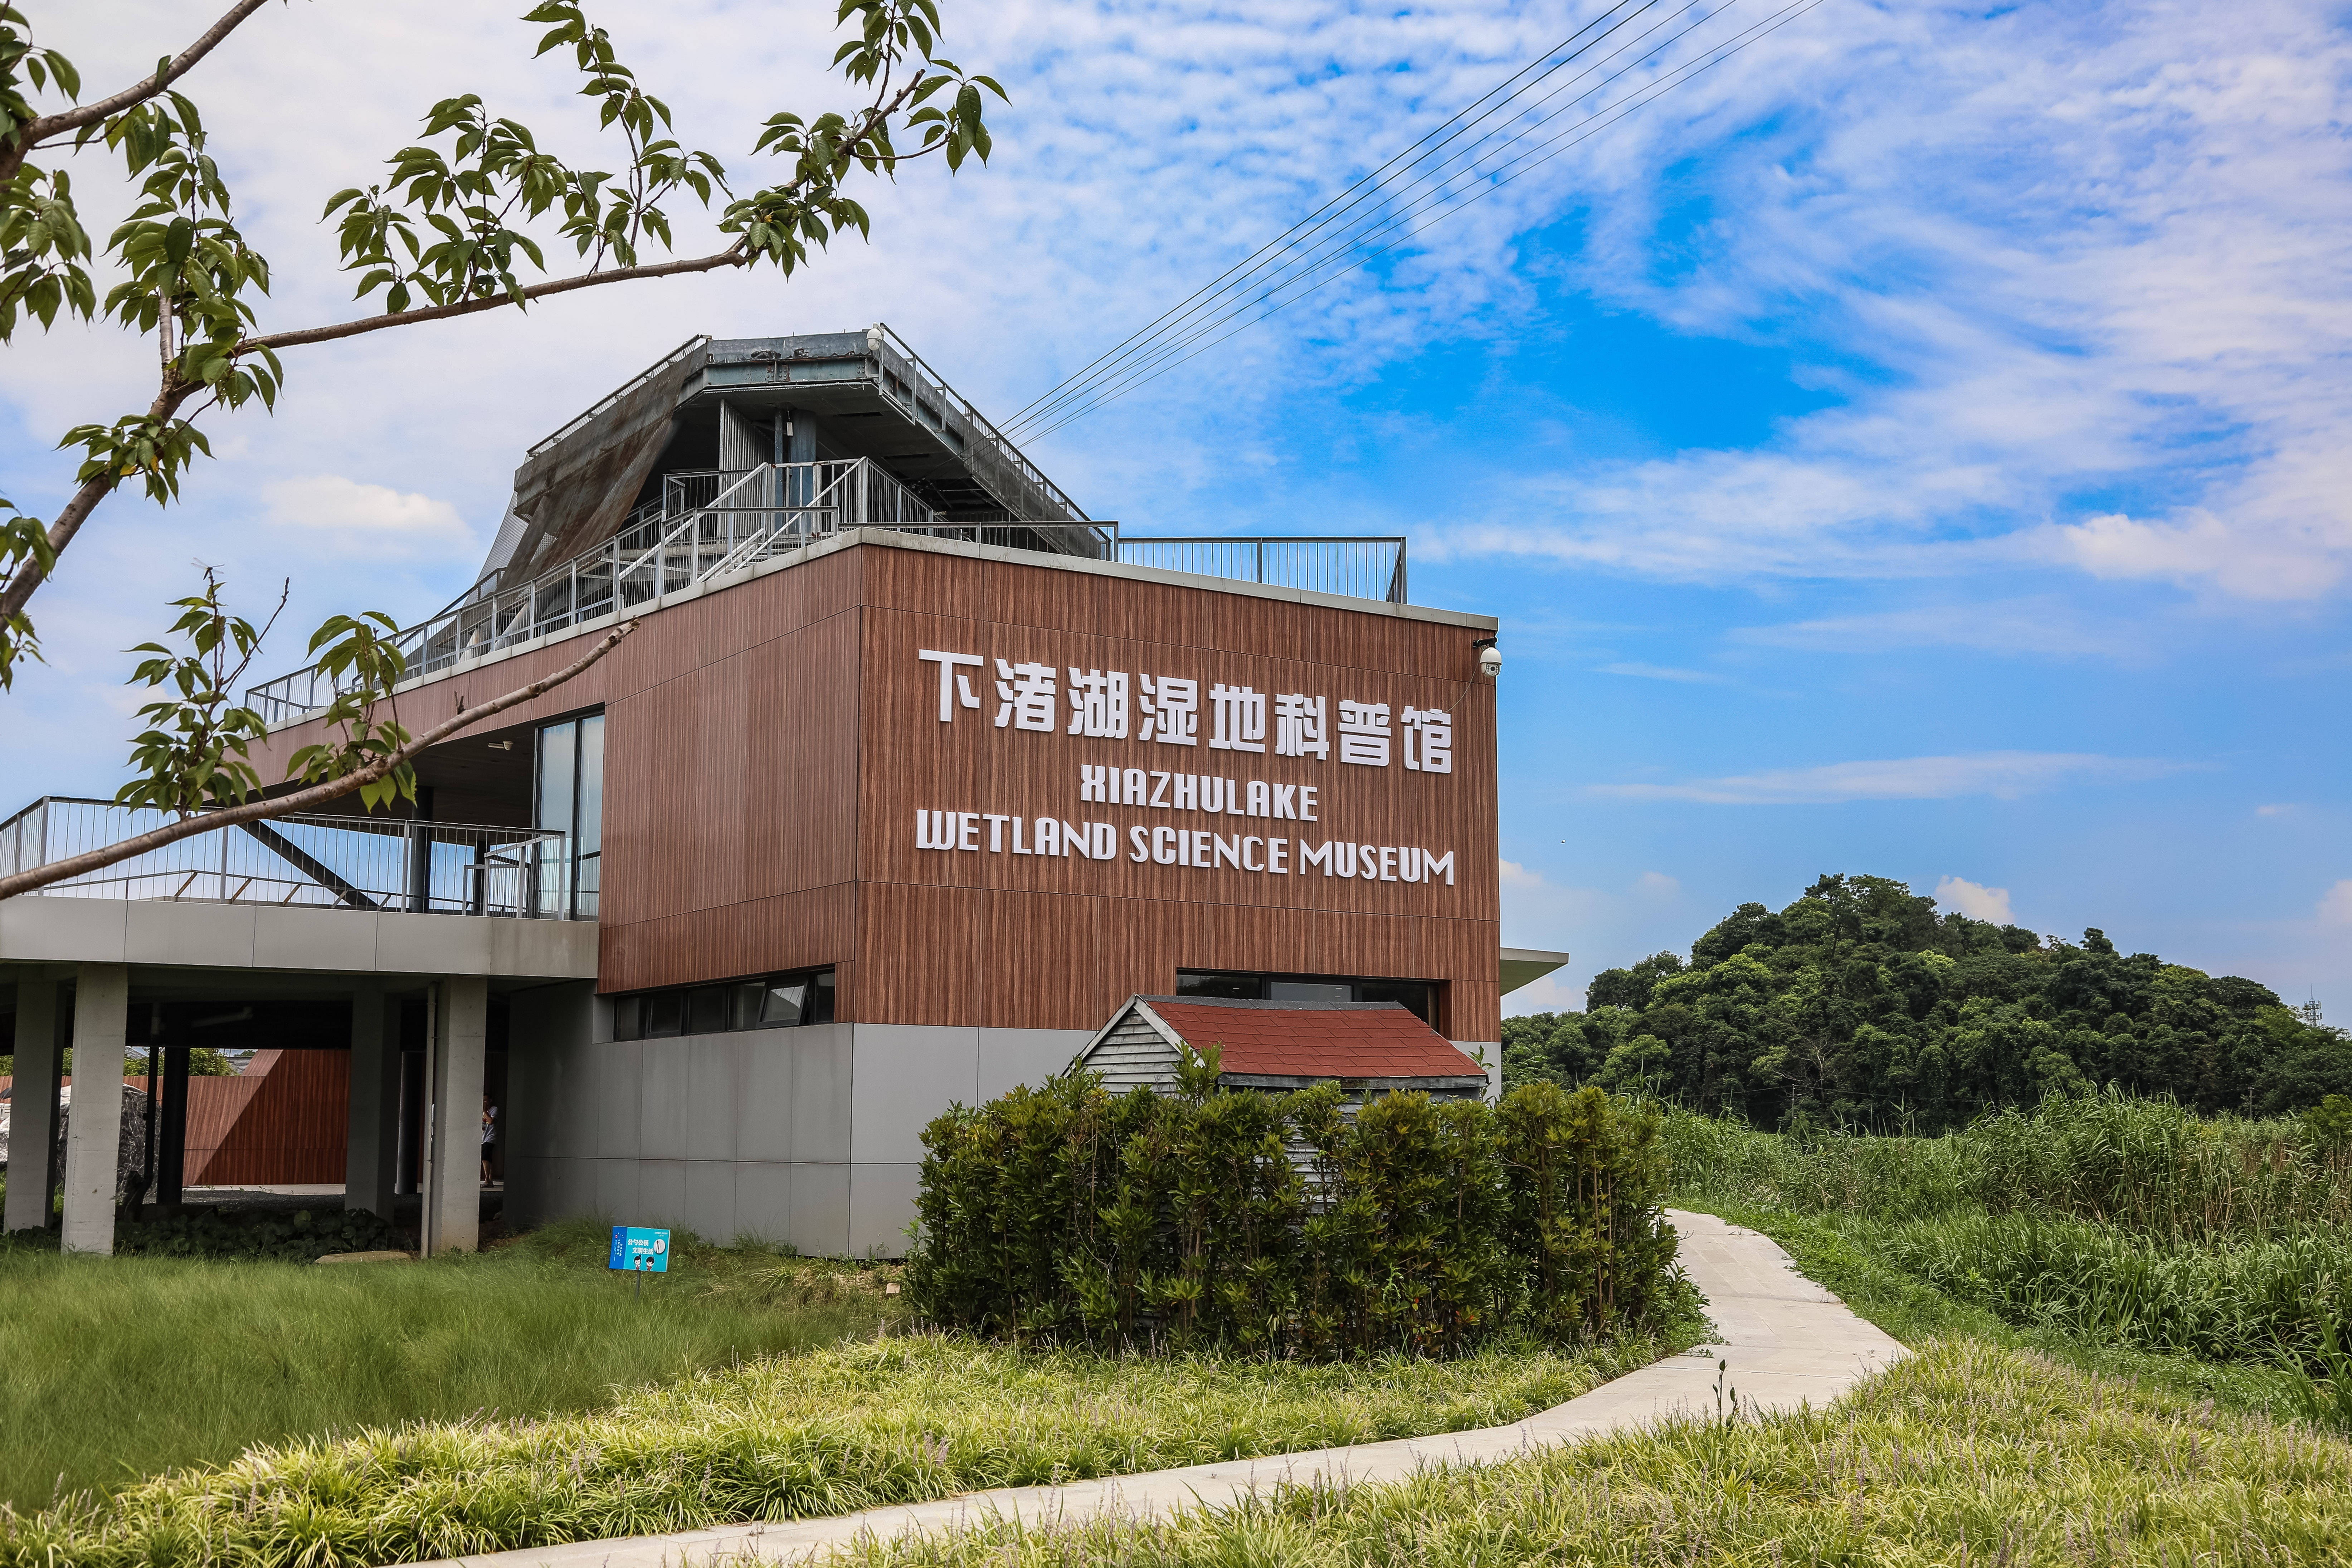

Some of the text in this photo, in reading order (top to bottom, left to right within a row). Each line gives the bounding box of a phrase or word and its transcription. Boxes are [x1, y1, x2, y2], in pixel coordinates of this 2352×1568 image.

[918, 649, 1452, 774] 下渚湖湿地科普馆
[1080, 764, 1318, 822] XIAZHULAKE
[915, 809, 1455, 886] WETLAND SCIENCE MUSEUM
